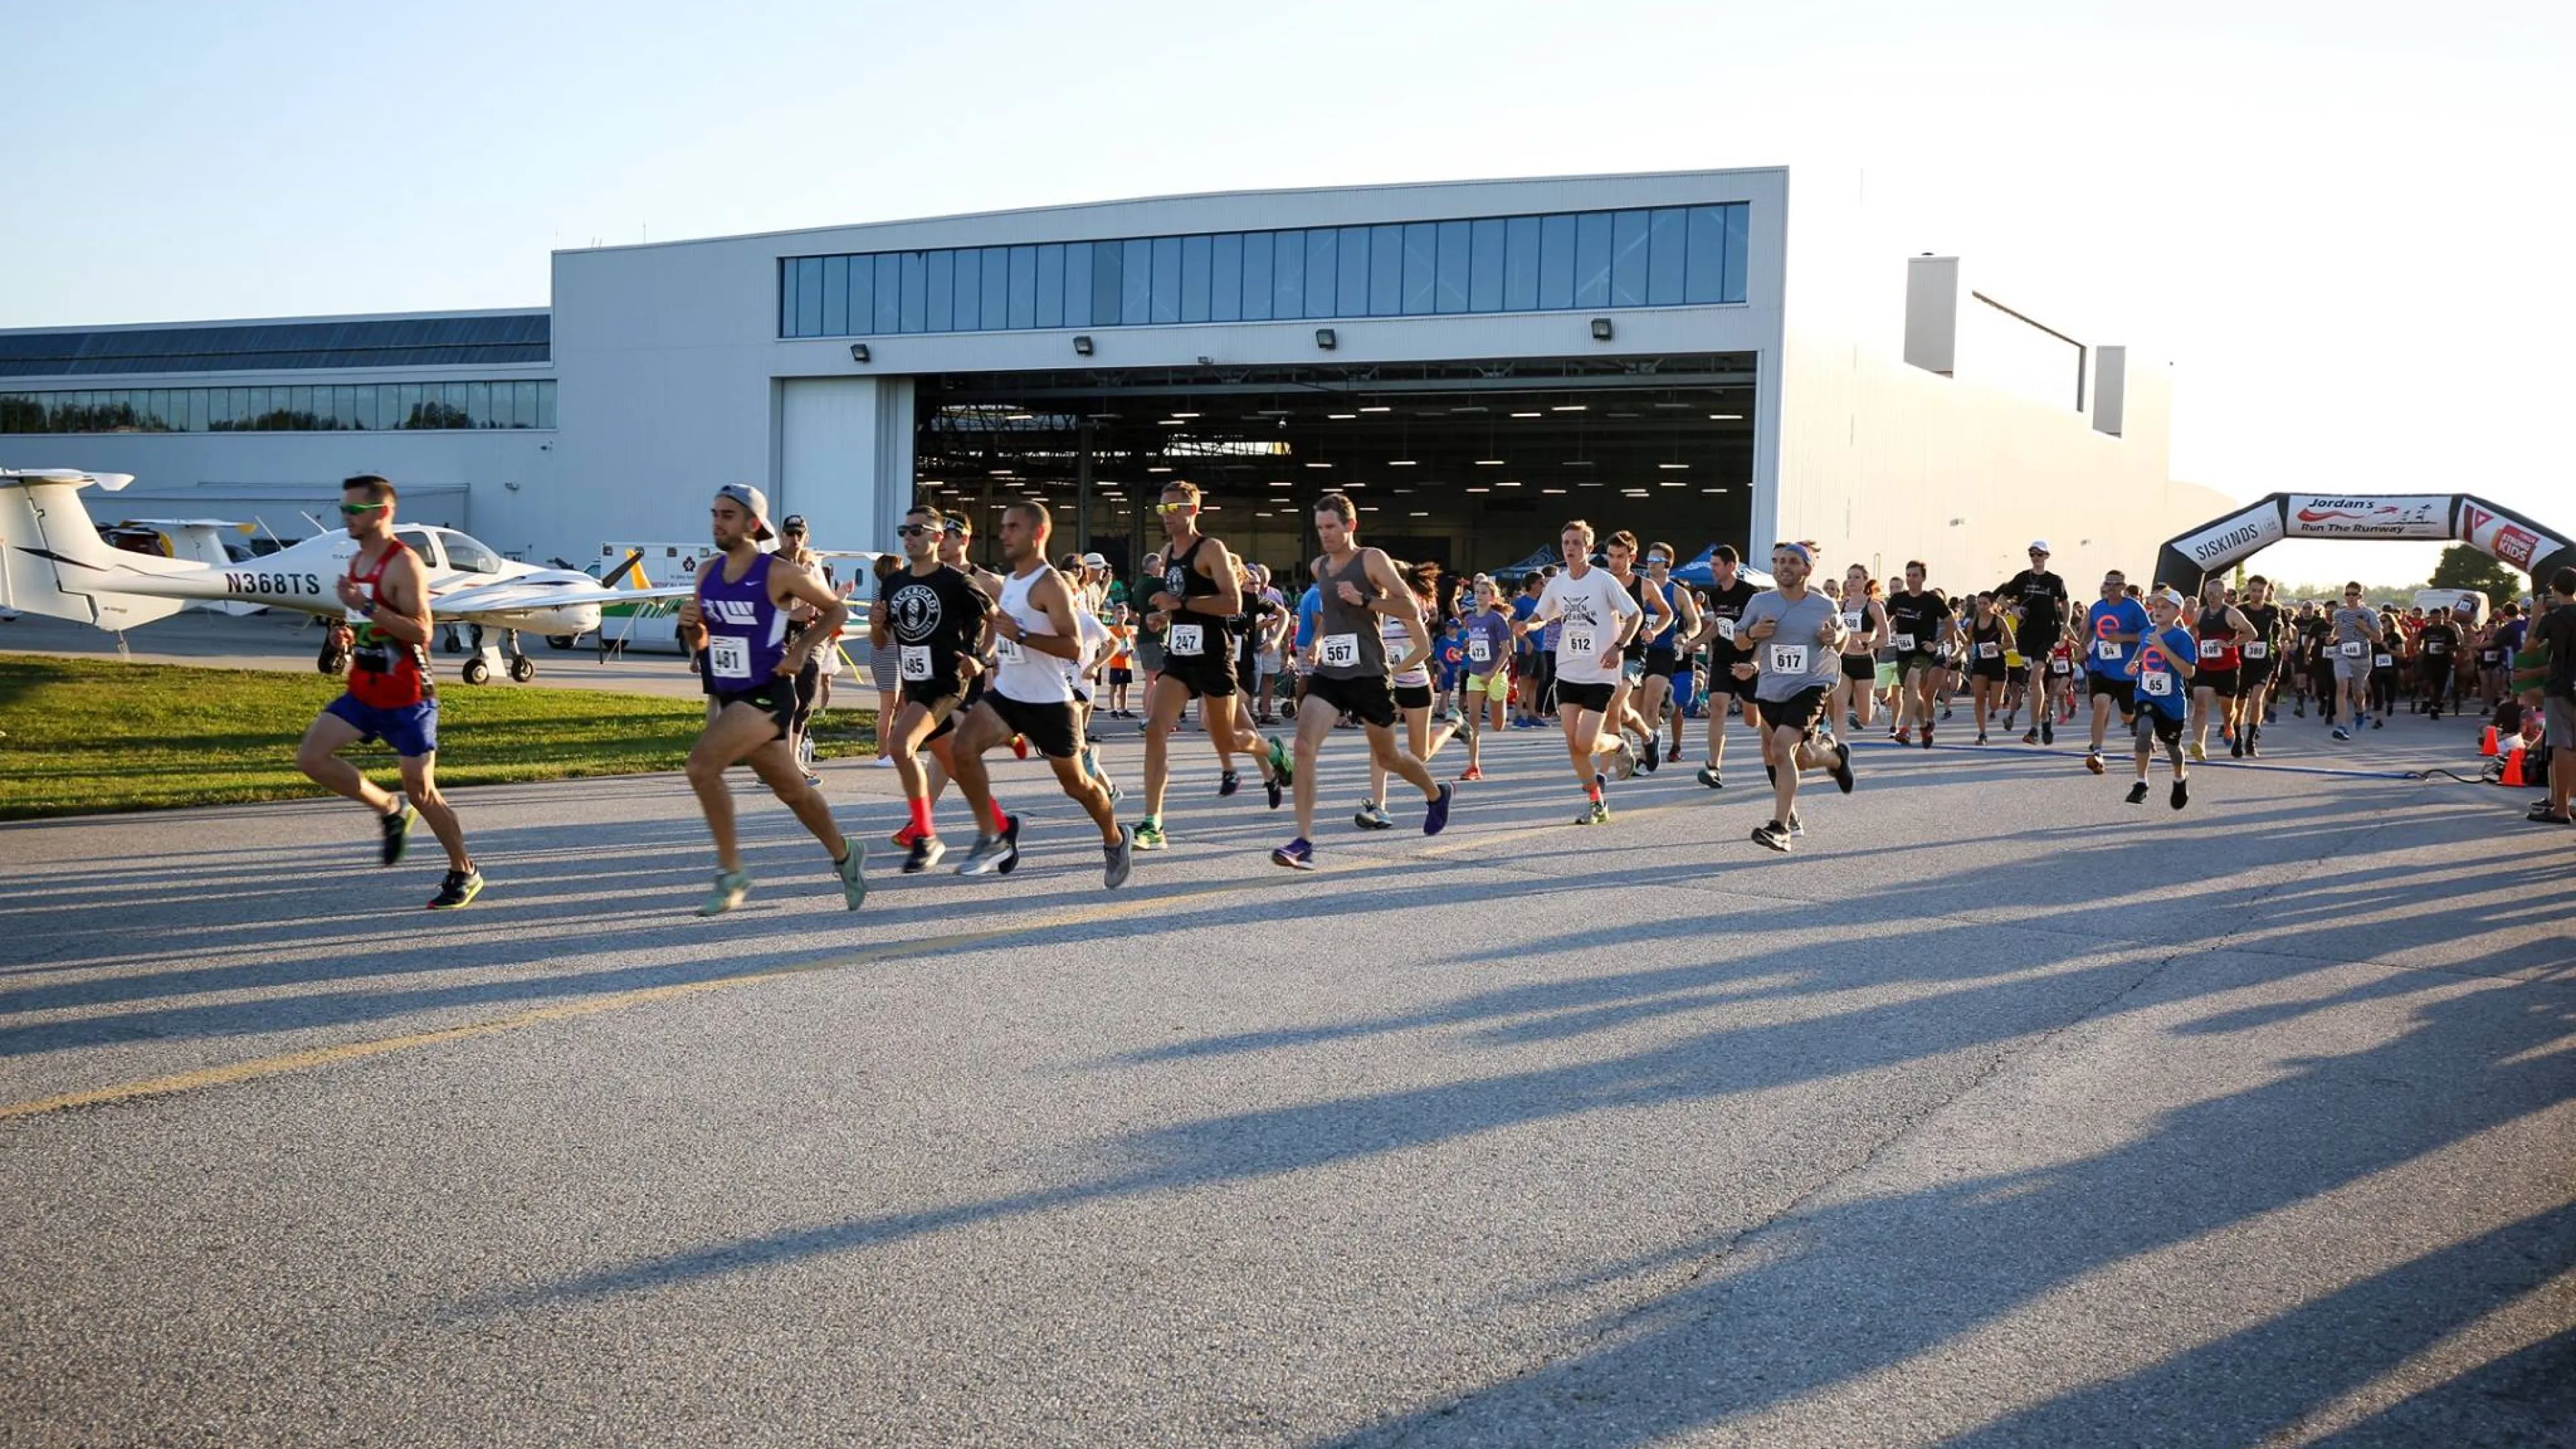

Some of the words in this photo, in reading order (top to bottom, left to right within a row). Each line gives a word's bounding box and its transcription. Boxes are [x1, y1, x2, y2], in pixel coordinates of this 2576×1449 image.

[2308, 498, 2375, 509] Jordan's
[2301, 523, 2324, 532] Run
[2328, 524, 2351, 533] The
[2353, 525, 2406, 535] Runway
[2196, 523, 2259, 561] SISKINDS
[2497, 539, 2528, 561] KIDS
[225, 573, 321, 595] N368TS
[1175, 635, 1197, 650] 247
[715, 649, 739, 670] 481
[1328, 645, 1352, 662] 567
[1778, 654, 1794, 669] 617
[904, 657, 924, 674] 485
[2149, 680, 2163, 692] 65
